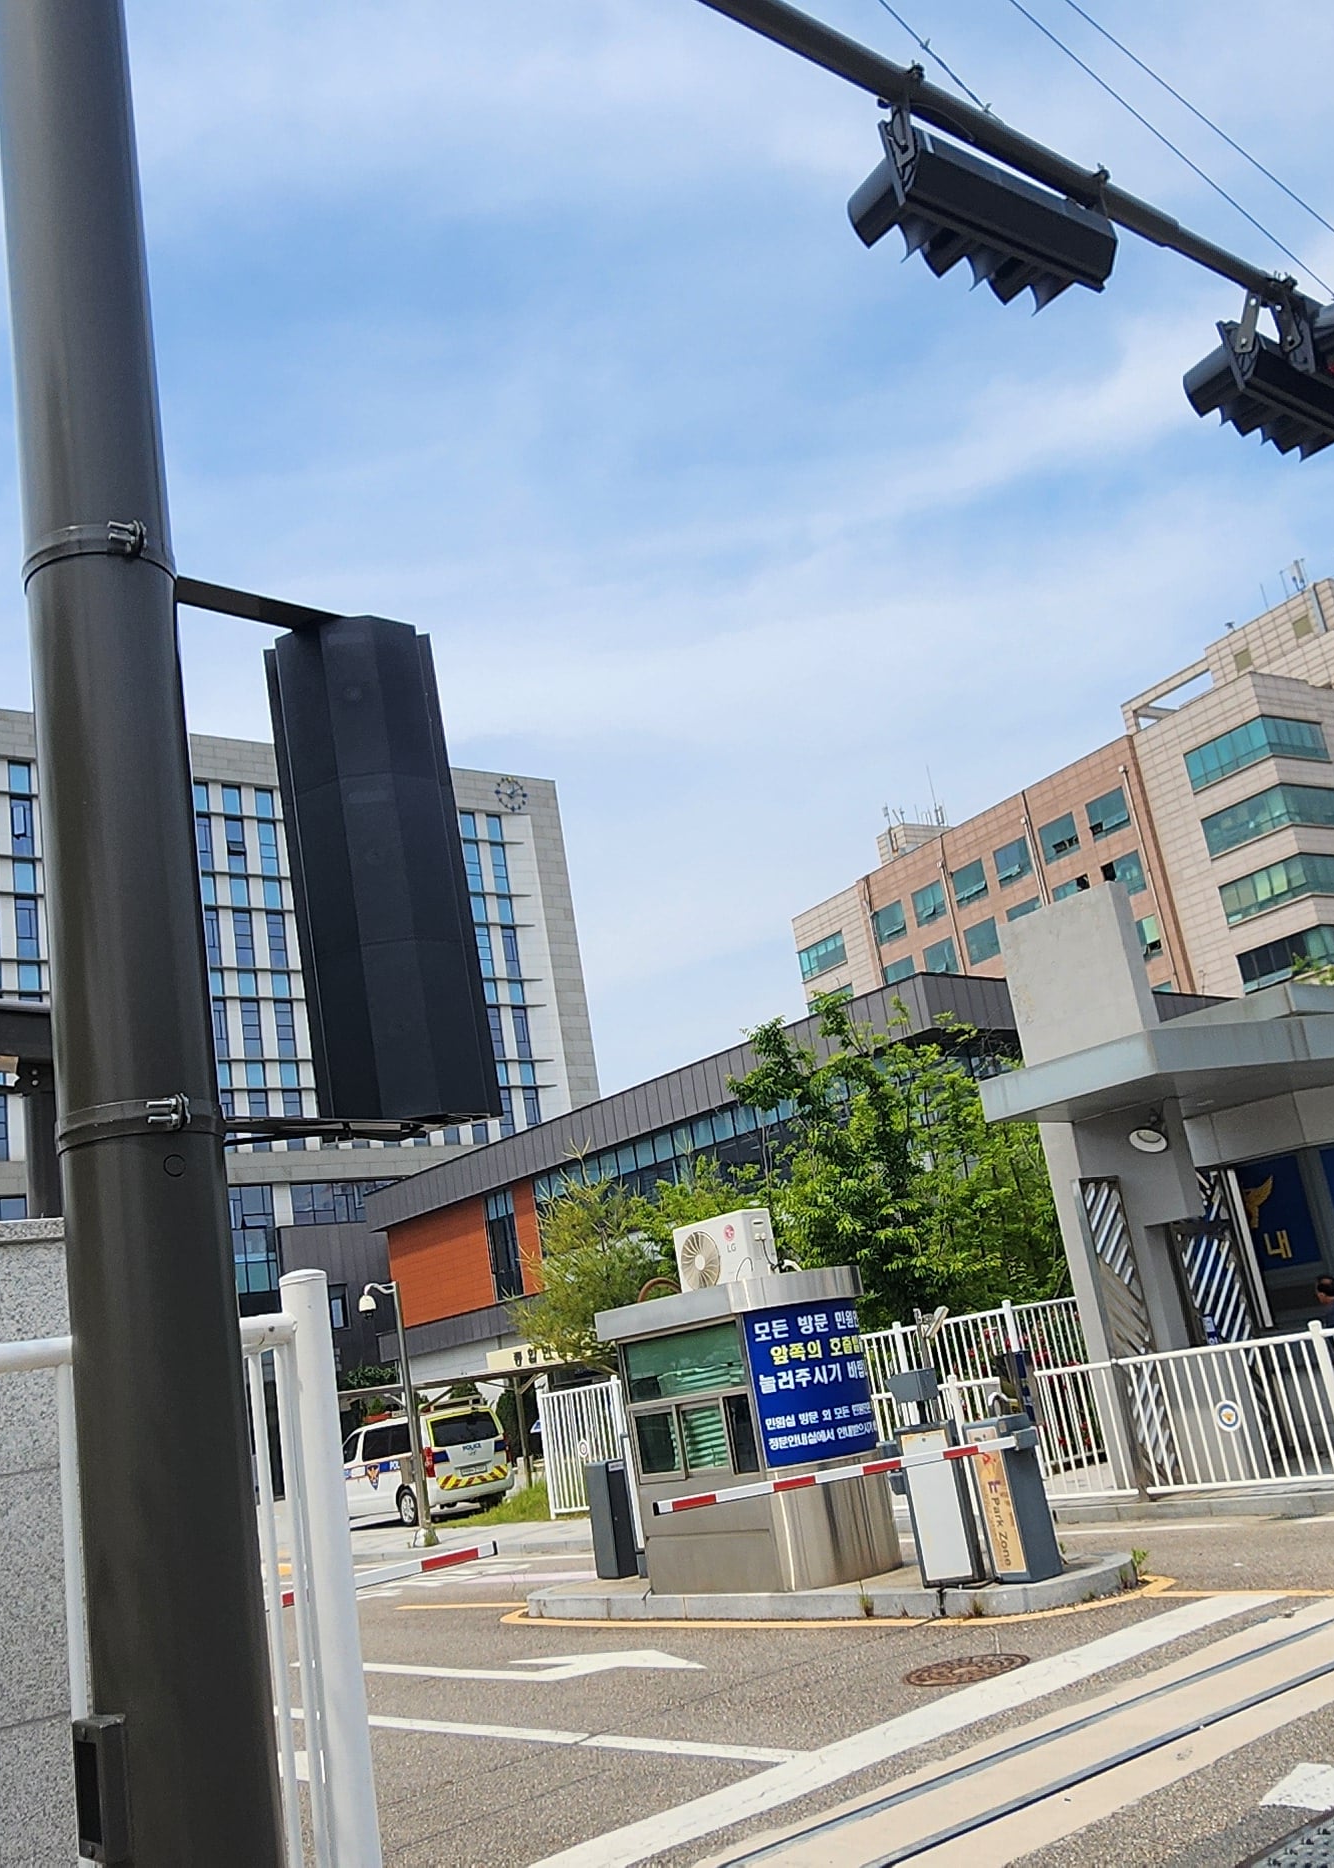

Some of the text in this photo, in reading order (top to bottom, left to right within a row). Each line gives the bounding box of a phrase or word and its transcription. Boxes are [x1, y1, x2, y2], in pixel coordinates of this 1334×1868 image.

[727, 1243, 737, 1253] LG
[1263, 1229, 1293, 1259] 내
[754, 1319, 789, 1342] 모든
[797, 1313, 829, 1335] 방문
[770, 1335, 864, 1366] 앞쪽의 호출벨
[765, 1414, 796, 1431] 민원실
[798, 1411, 819, 1426] 방문
[821, 1408, 832, 1421] 외
[834, 1405, 850, 1419] 모든
[462, 1442, 482, 1451] POLICE
[768, 1428, 835, 1451] 정문안내실에서
[389, 1460, 401, 1470] POL
[991, 1497, 1012, 1567] Park Zone
